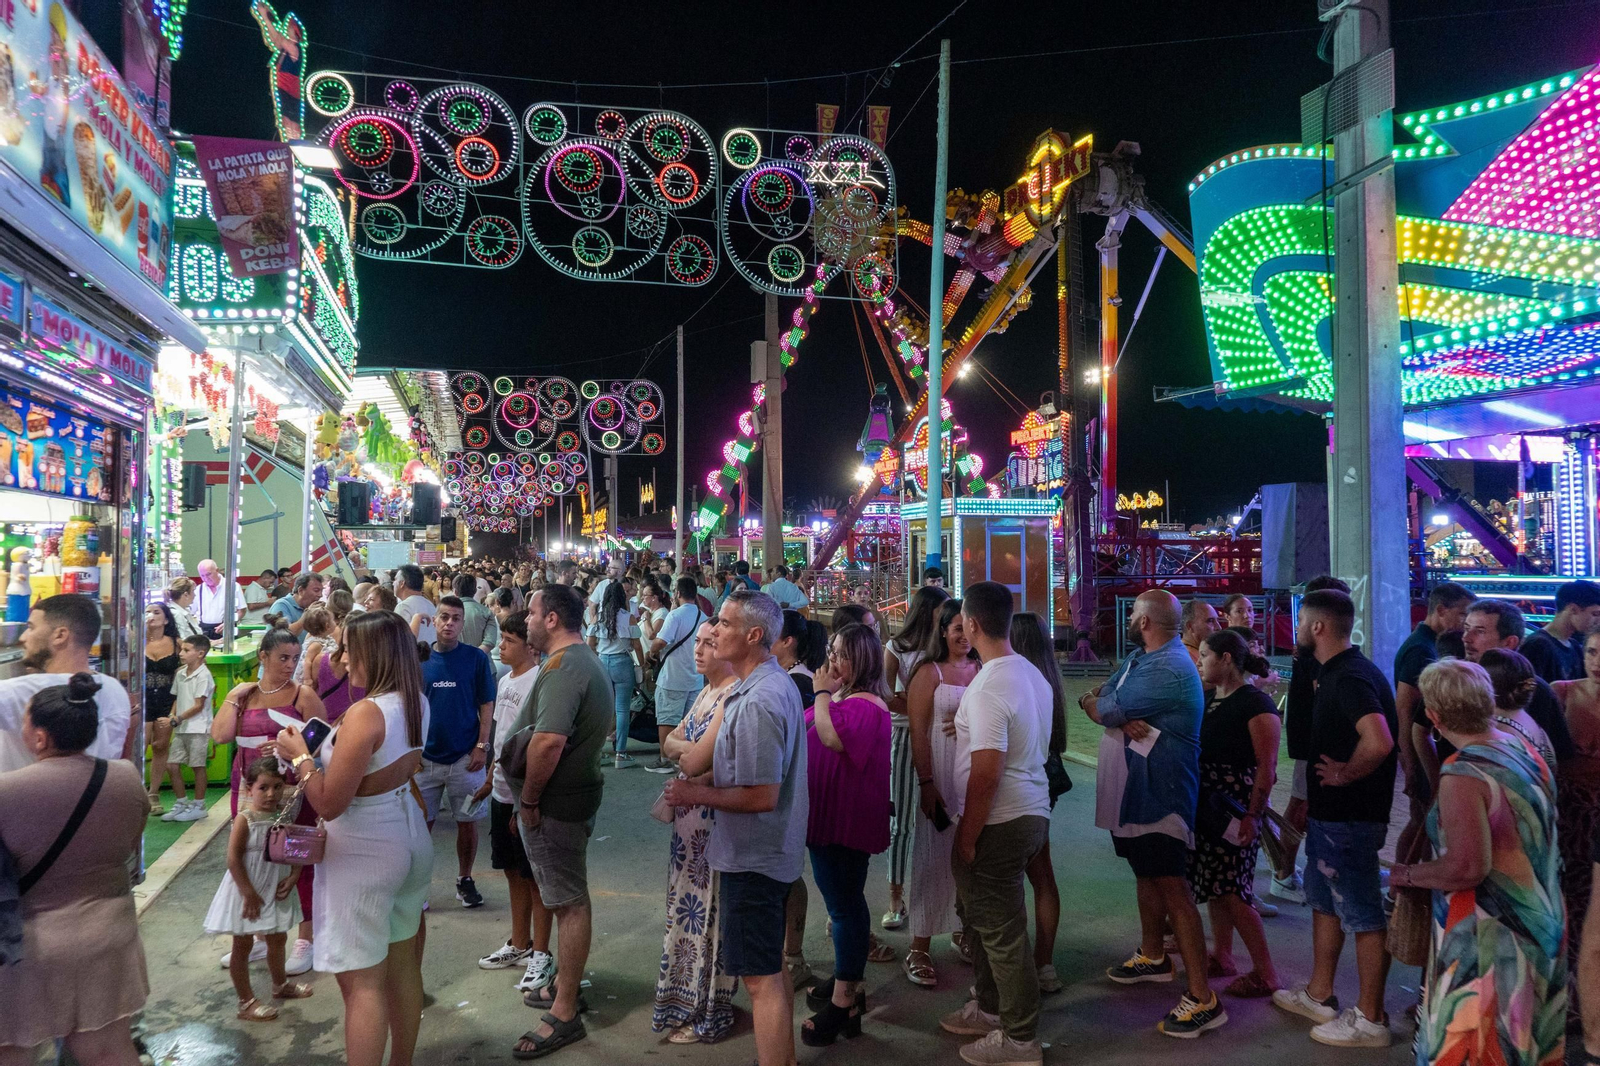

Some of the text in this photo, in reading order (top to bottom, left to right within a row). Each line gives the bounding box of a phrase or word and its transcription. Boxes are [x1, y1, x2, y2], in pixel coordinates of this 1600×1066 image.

[207, 148, 290, 170] LA PATATA QUE
[216, 161, 289, 183] MOLA Y MOLA
[97, 338, 108, 361] Y
